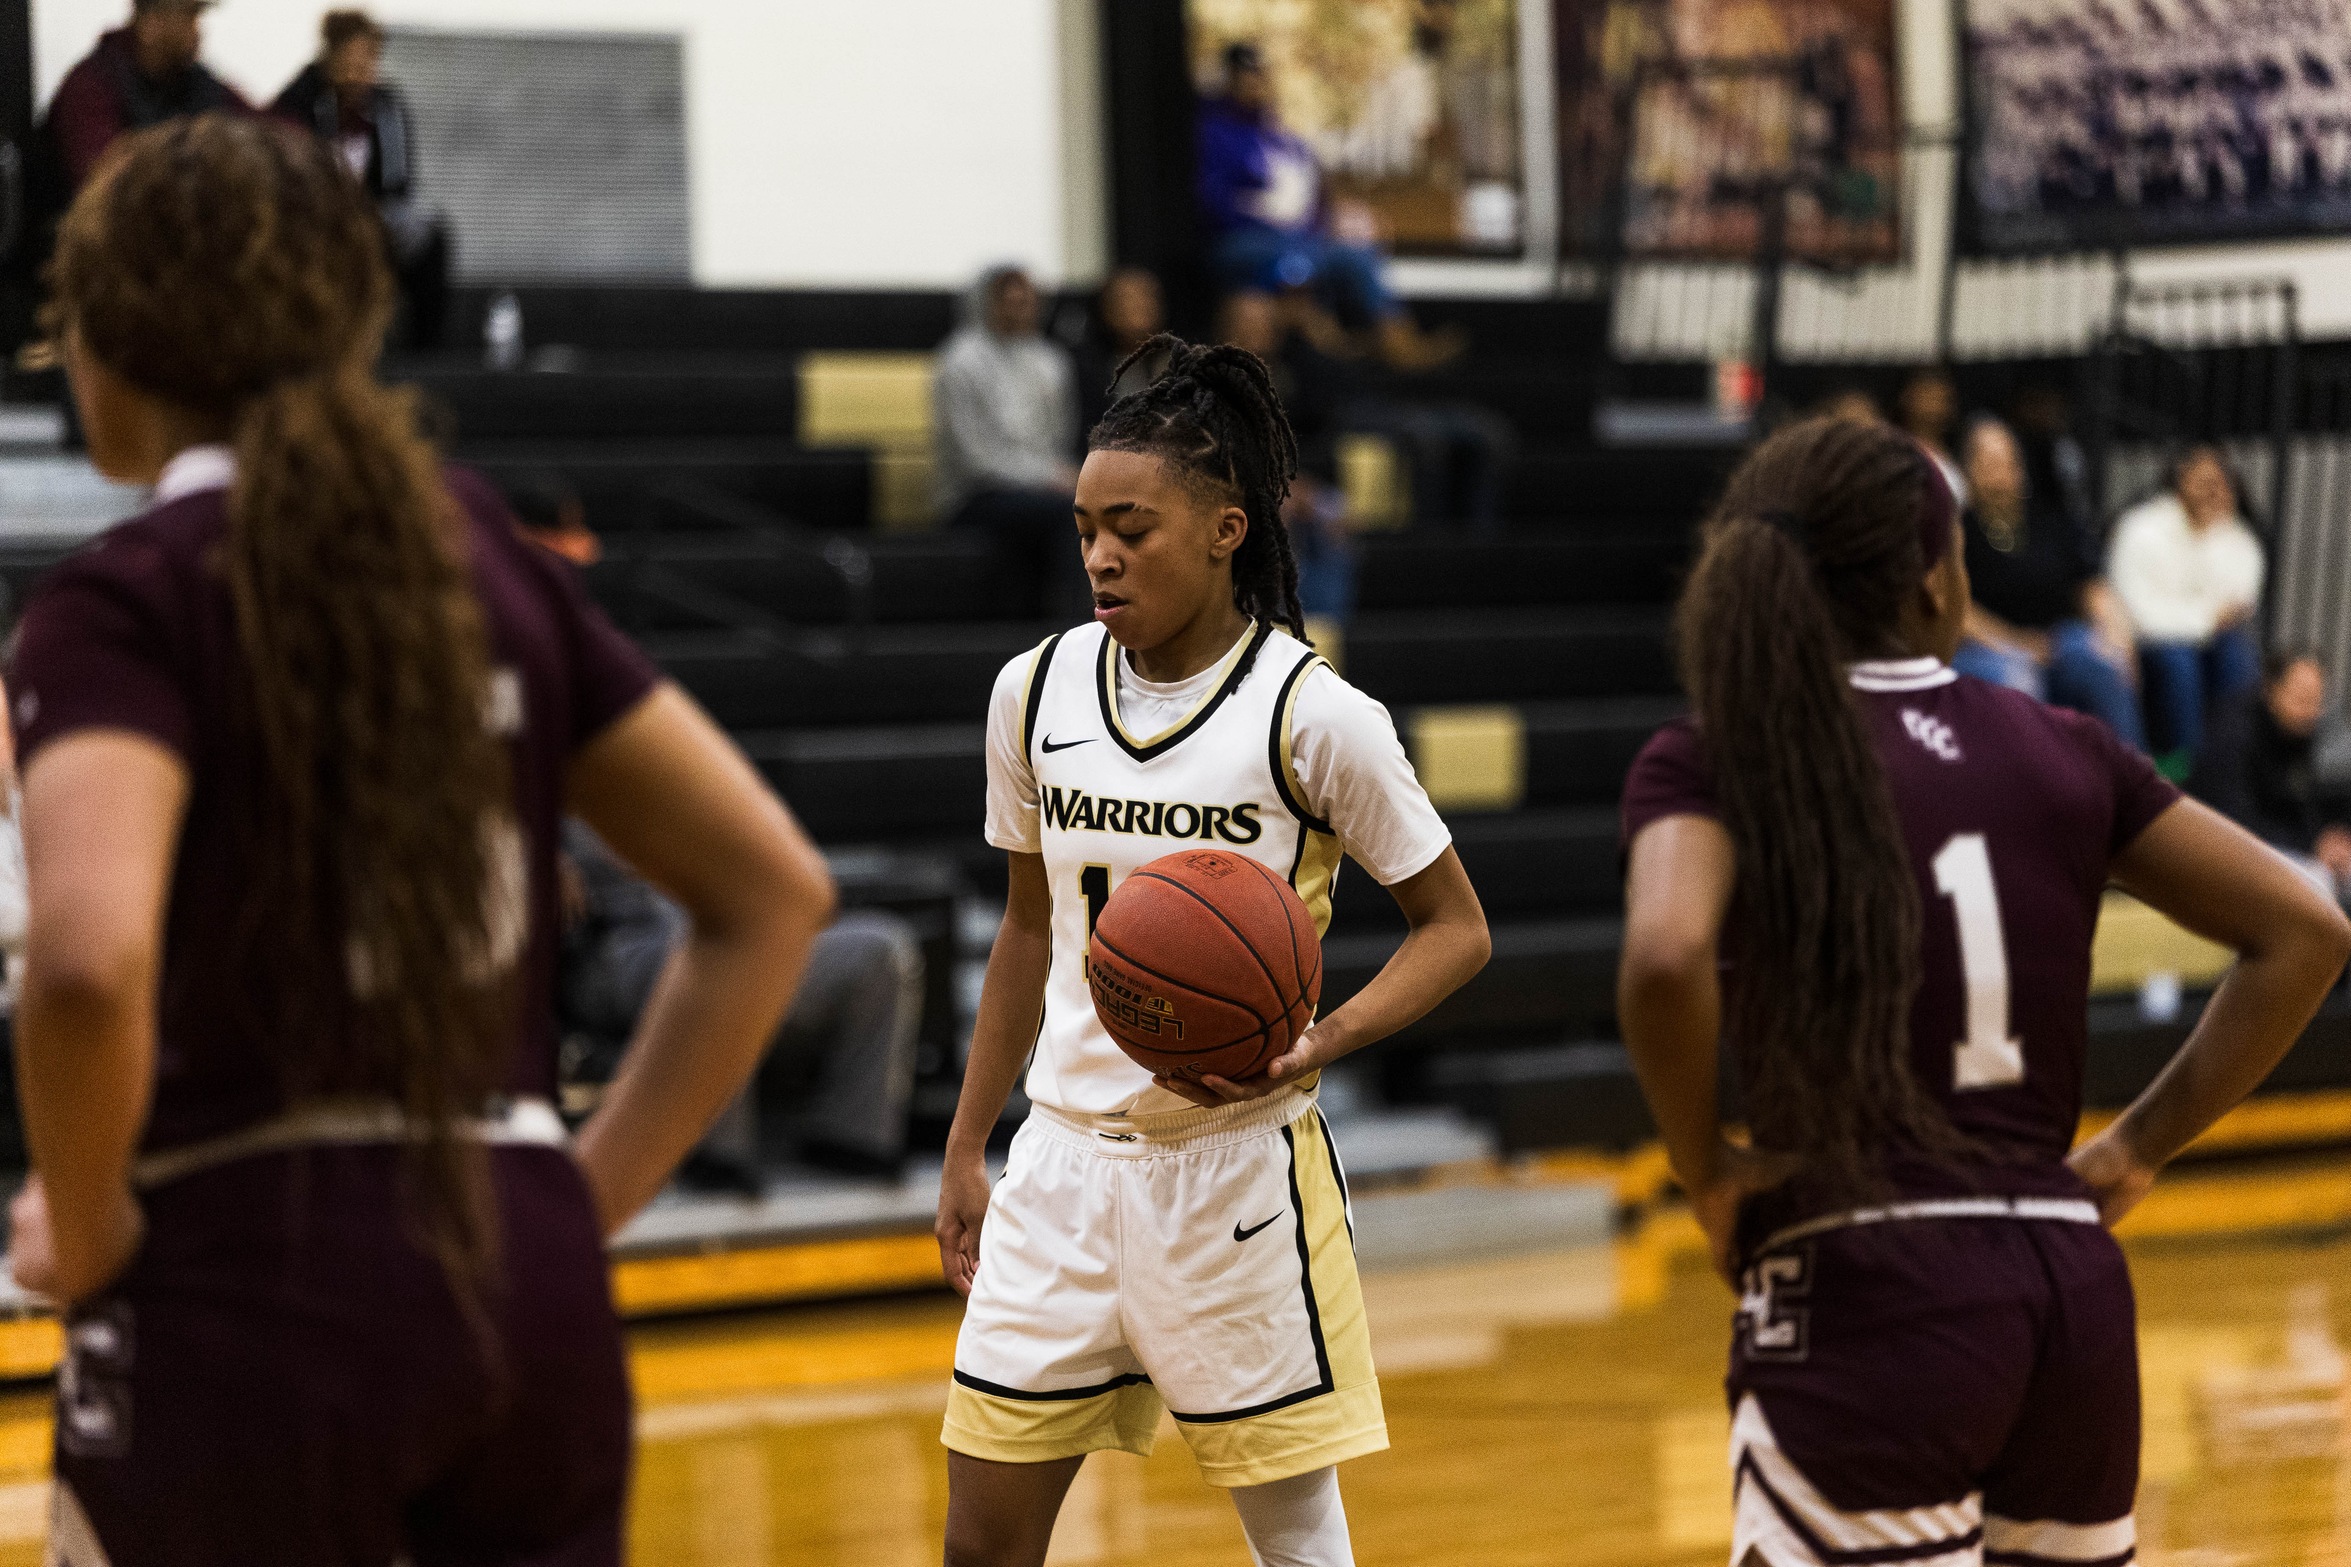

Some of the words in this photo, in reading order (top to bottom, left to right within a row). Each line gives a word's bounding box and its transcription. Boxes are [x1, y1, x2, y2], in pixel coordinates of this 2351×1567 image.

[1041, 783, 1263, 846] WARRIORS
[1092, 963, 1143, 1006] 1000
[1127, 977, 1153, 993] OFFICIAL
[1931, 833, 2024, 1089] 1
[1089, 974, 1184, 1040] LEGAC
